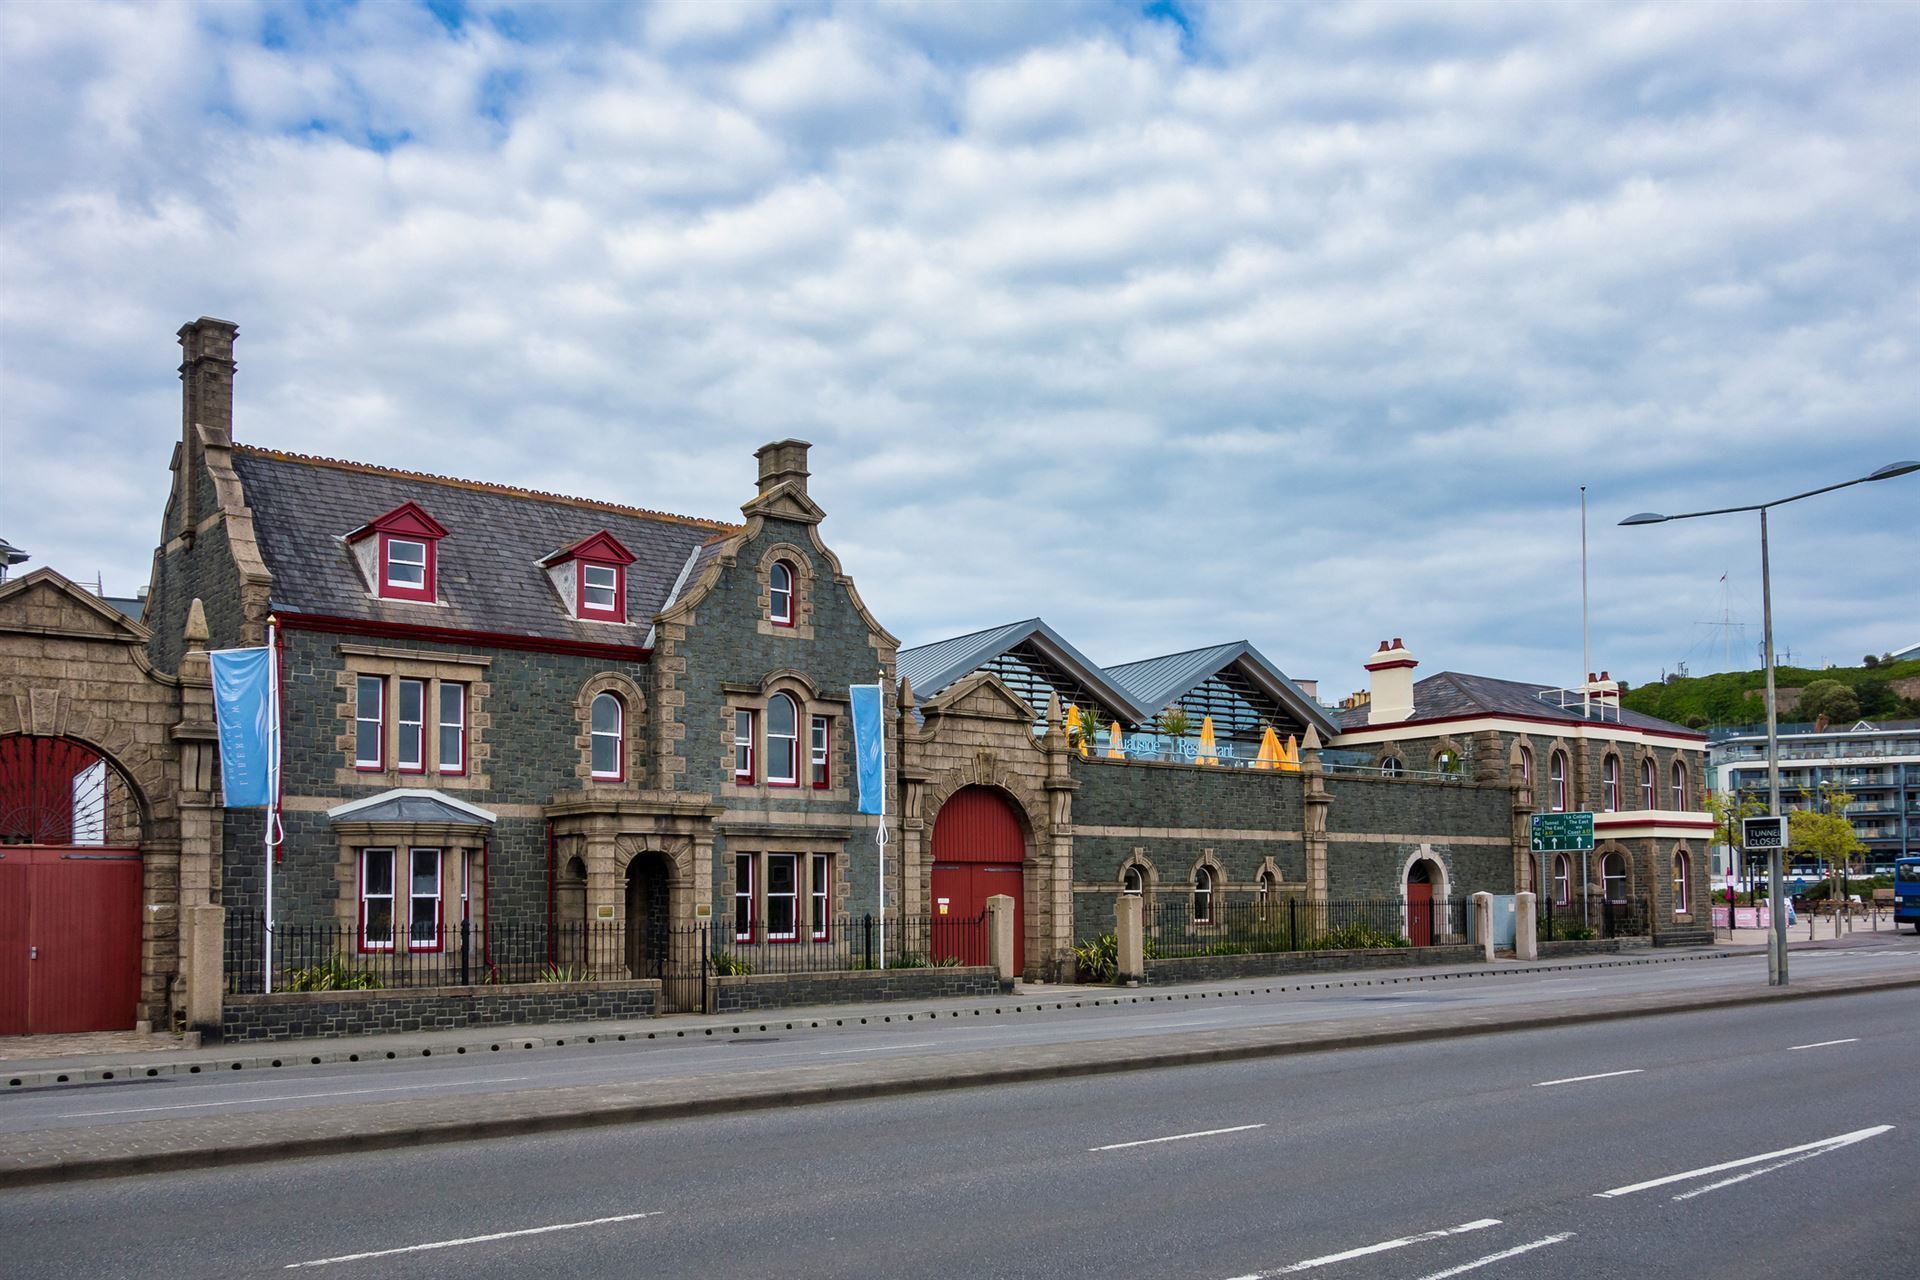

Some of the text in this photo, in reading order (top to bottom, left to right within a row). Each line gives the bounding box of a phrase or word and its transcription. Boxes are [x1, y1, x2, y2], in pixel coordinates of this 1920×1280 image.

[1178, 738, 1235, 759] Resrant
[1533, 817, 1540, 825] P
[1750, 829, 1780, 837] TUNNEL
[1749, 838, 1781, 846] CLOSED
